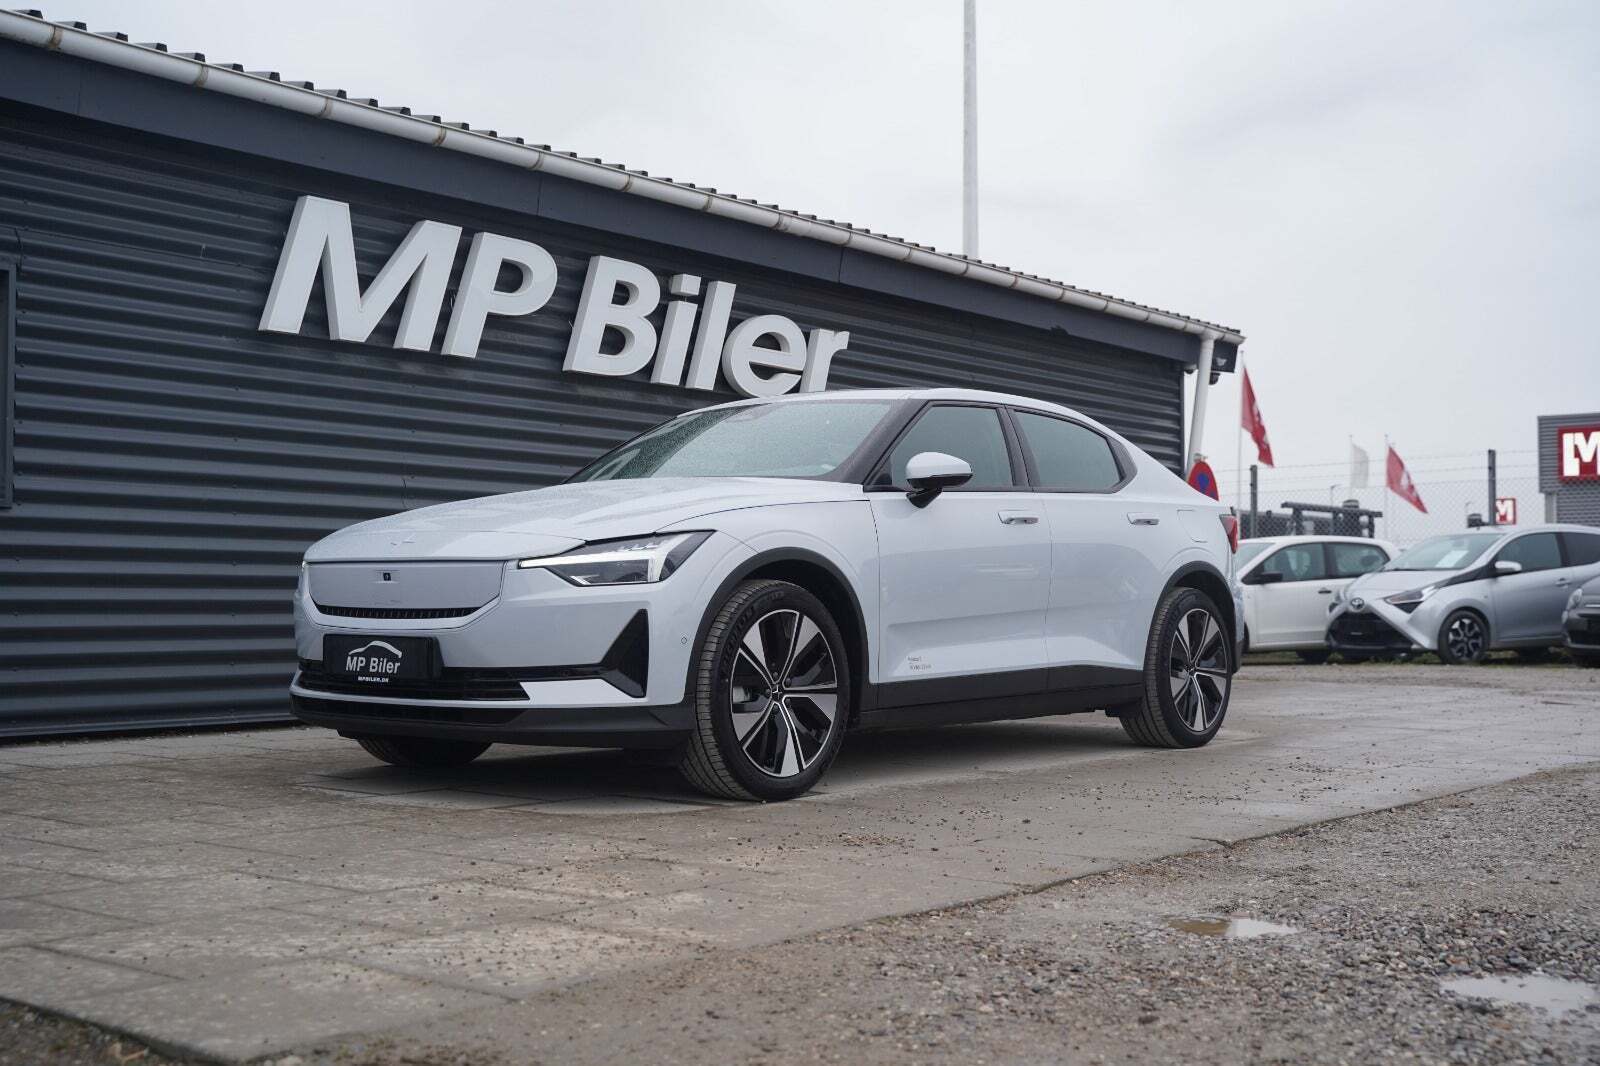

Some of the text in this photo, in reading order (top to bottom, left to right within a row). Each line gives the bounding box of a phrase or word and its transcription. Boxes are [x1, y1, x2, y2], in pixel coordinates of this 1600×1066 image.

[258, 195, 850, 398] MP Biler
[346, 656, 400, 673] MP Biler
